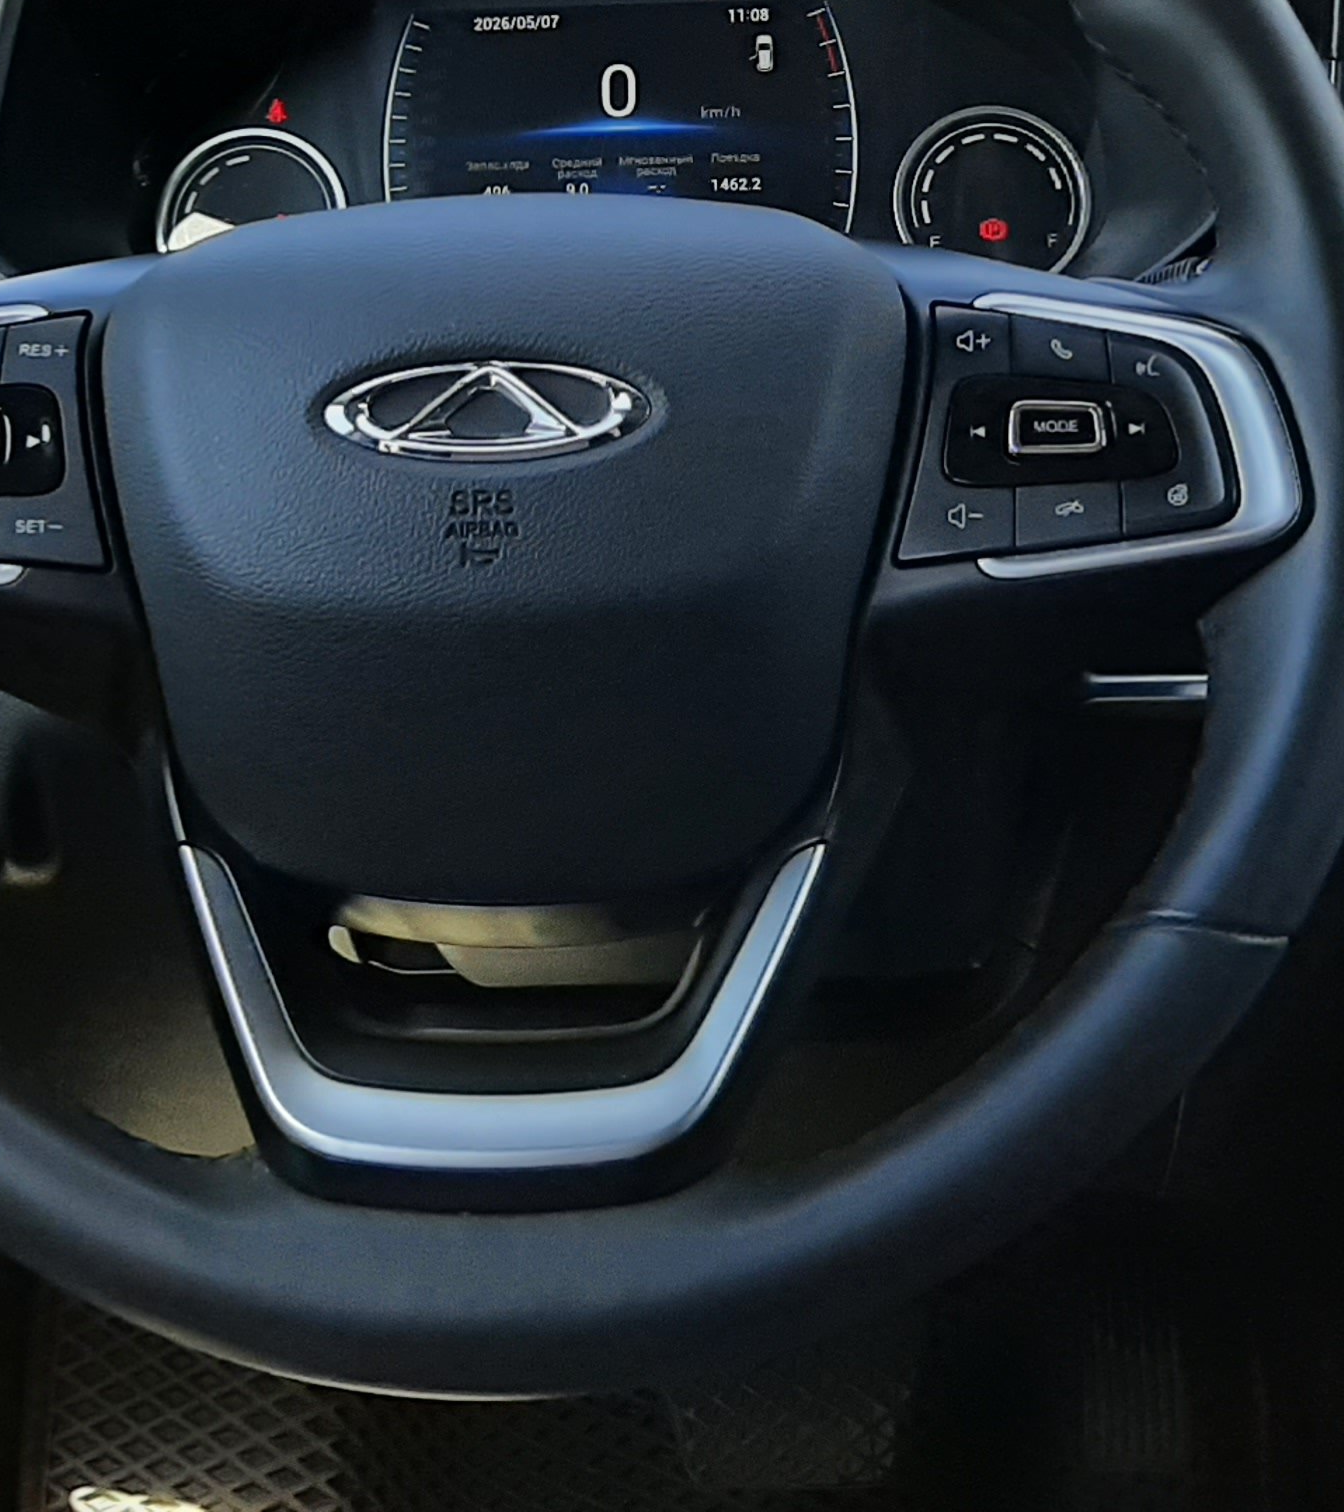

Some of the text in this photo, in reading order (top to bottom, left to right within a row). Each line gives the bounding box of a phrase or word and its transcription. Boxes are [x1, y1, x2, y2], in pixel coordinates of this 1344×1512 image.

[473, 7, 769, 32] 2026/05/07 11:08
[599, 63, 741, 119] 0 km/h
[552, 156, 603, 169] Средний
[711, 177, 762, 192] 1462.2
[1033, 418, 1079, 434] MODE
[448, 488, 515, 518] SRS
[444, 519, 520, 540] AIRBAG
